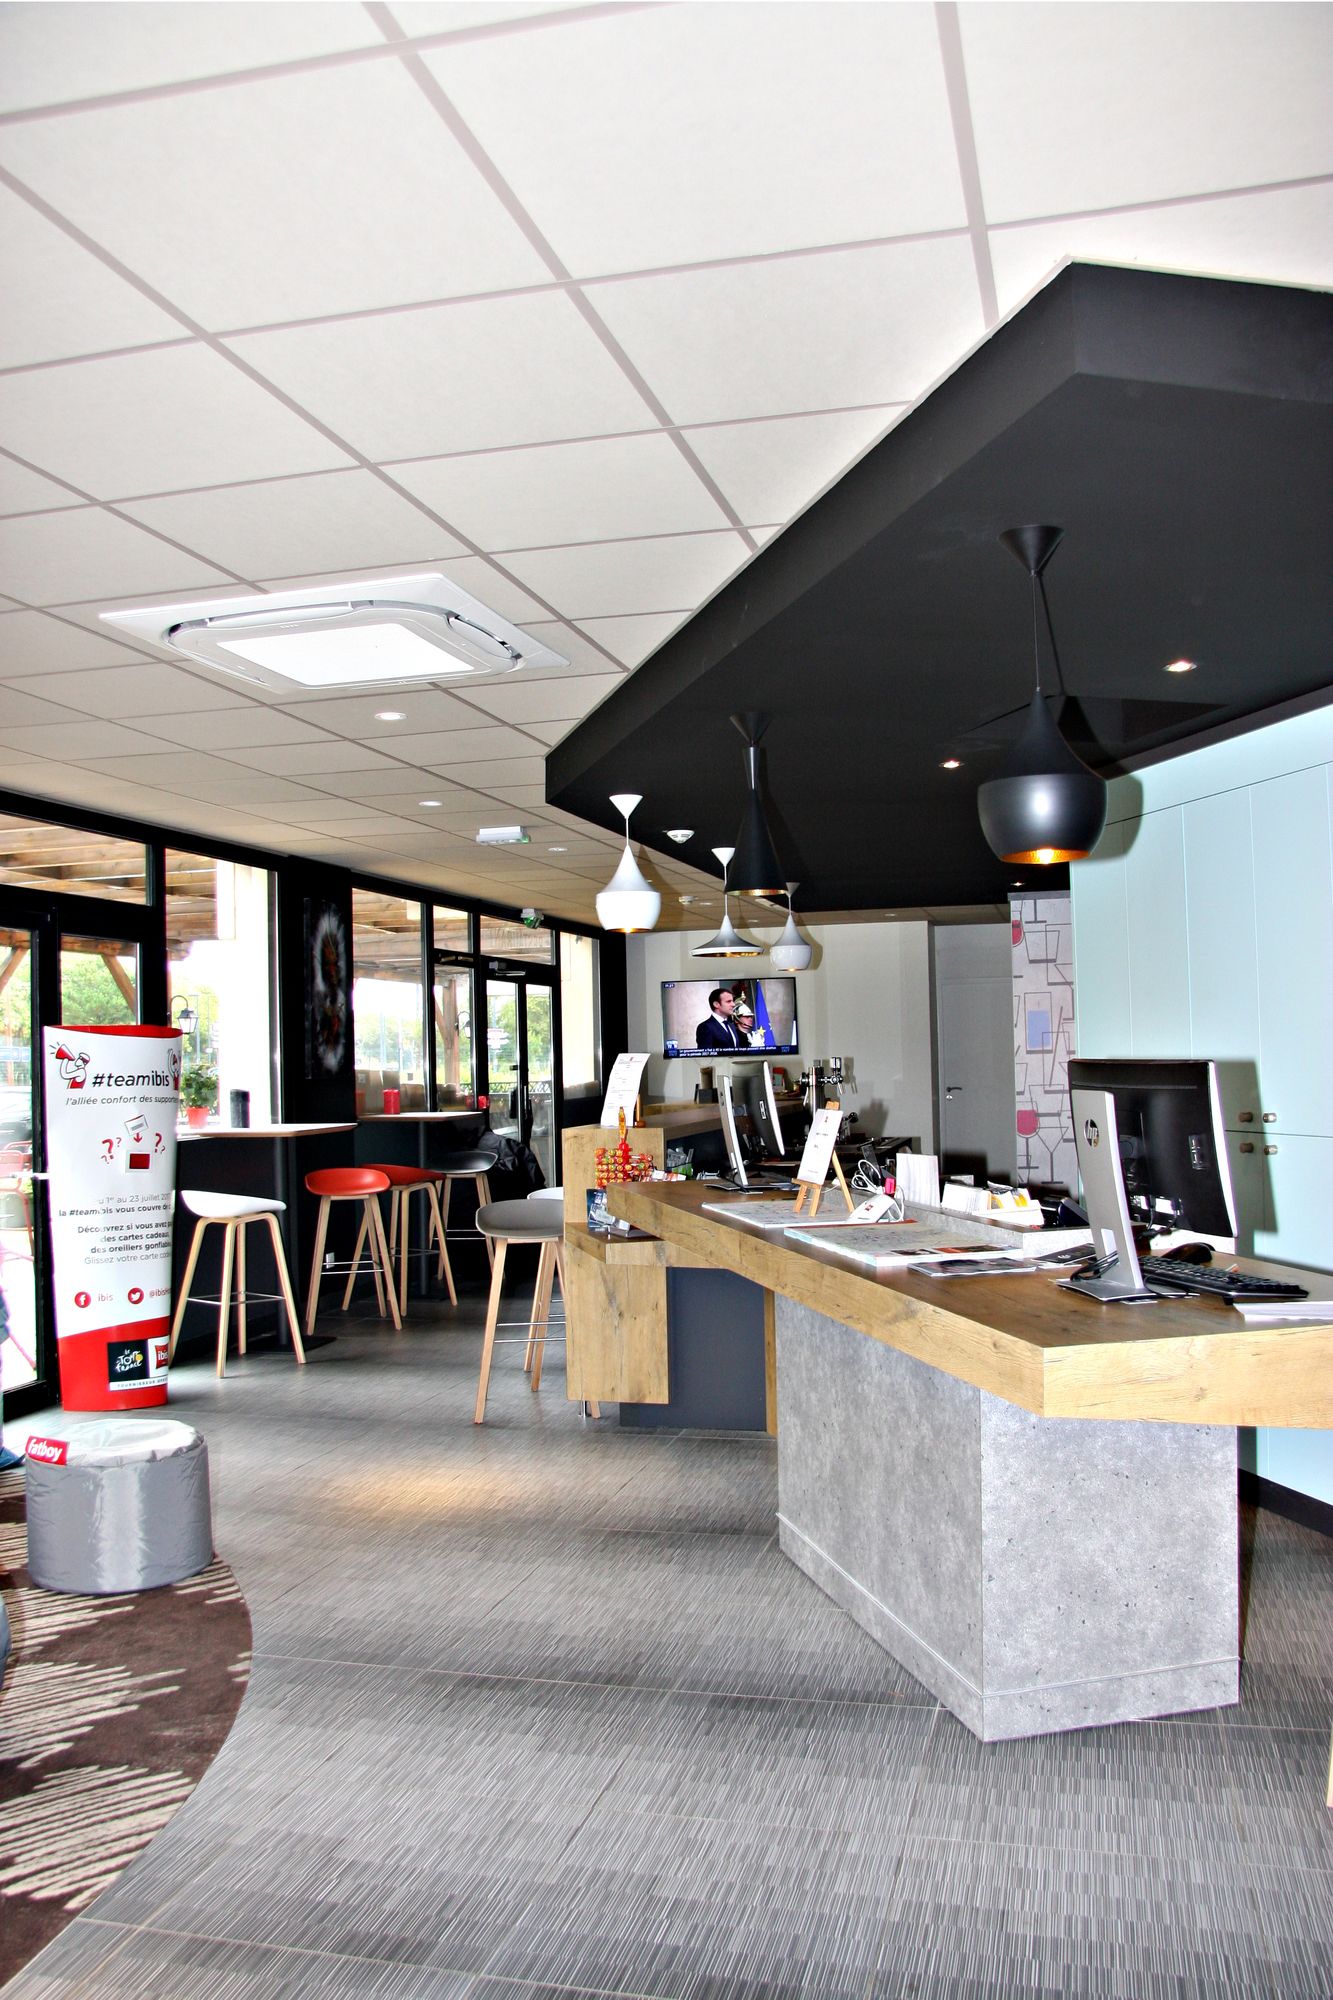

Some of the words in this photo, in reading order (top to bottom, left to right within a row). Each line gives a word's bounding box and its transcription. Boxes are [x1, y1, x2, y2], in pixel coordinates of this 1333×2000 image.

[92, 1070, 170, 1087] #teamibis
[66, 1096, 98, 1105] l'alliée
[101, 1095, 137, 1104] confort
[140, 1095, 153, 1103] des
[141, 1193, 160, 1203] juillet
[59, 1209, 67, 1217] la
[126, 1222, 133, 1231] si
[135, 1222, 153, 1230] vous
[118, 1233, 144, 1242] cartes
[90, 1246, 107, 1254] des
[108, 1242, 143, 1253] oreillers
[85, 1255, 114, 1265] Glissez
[116, 1253, 138, 1263] votre
[140, 1251, 159, 1261] carte
[98, 1293, 114, 1302] ibis
[28, 1438, 63, 1462] fatboy
